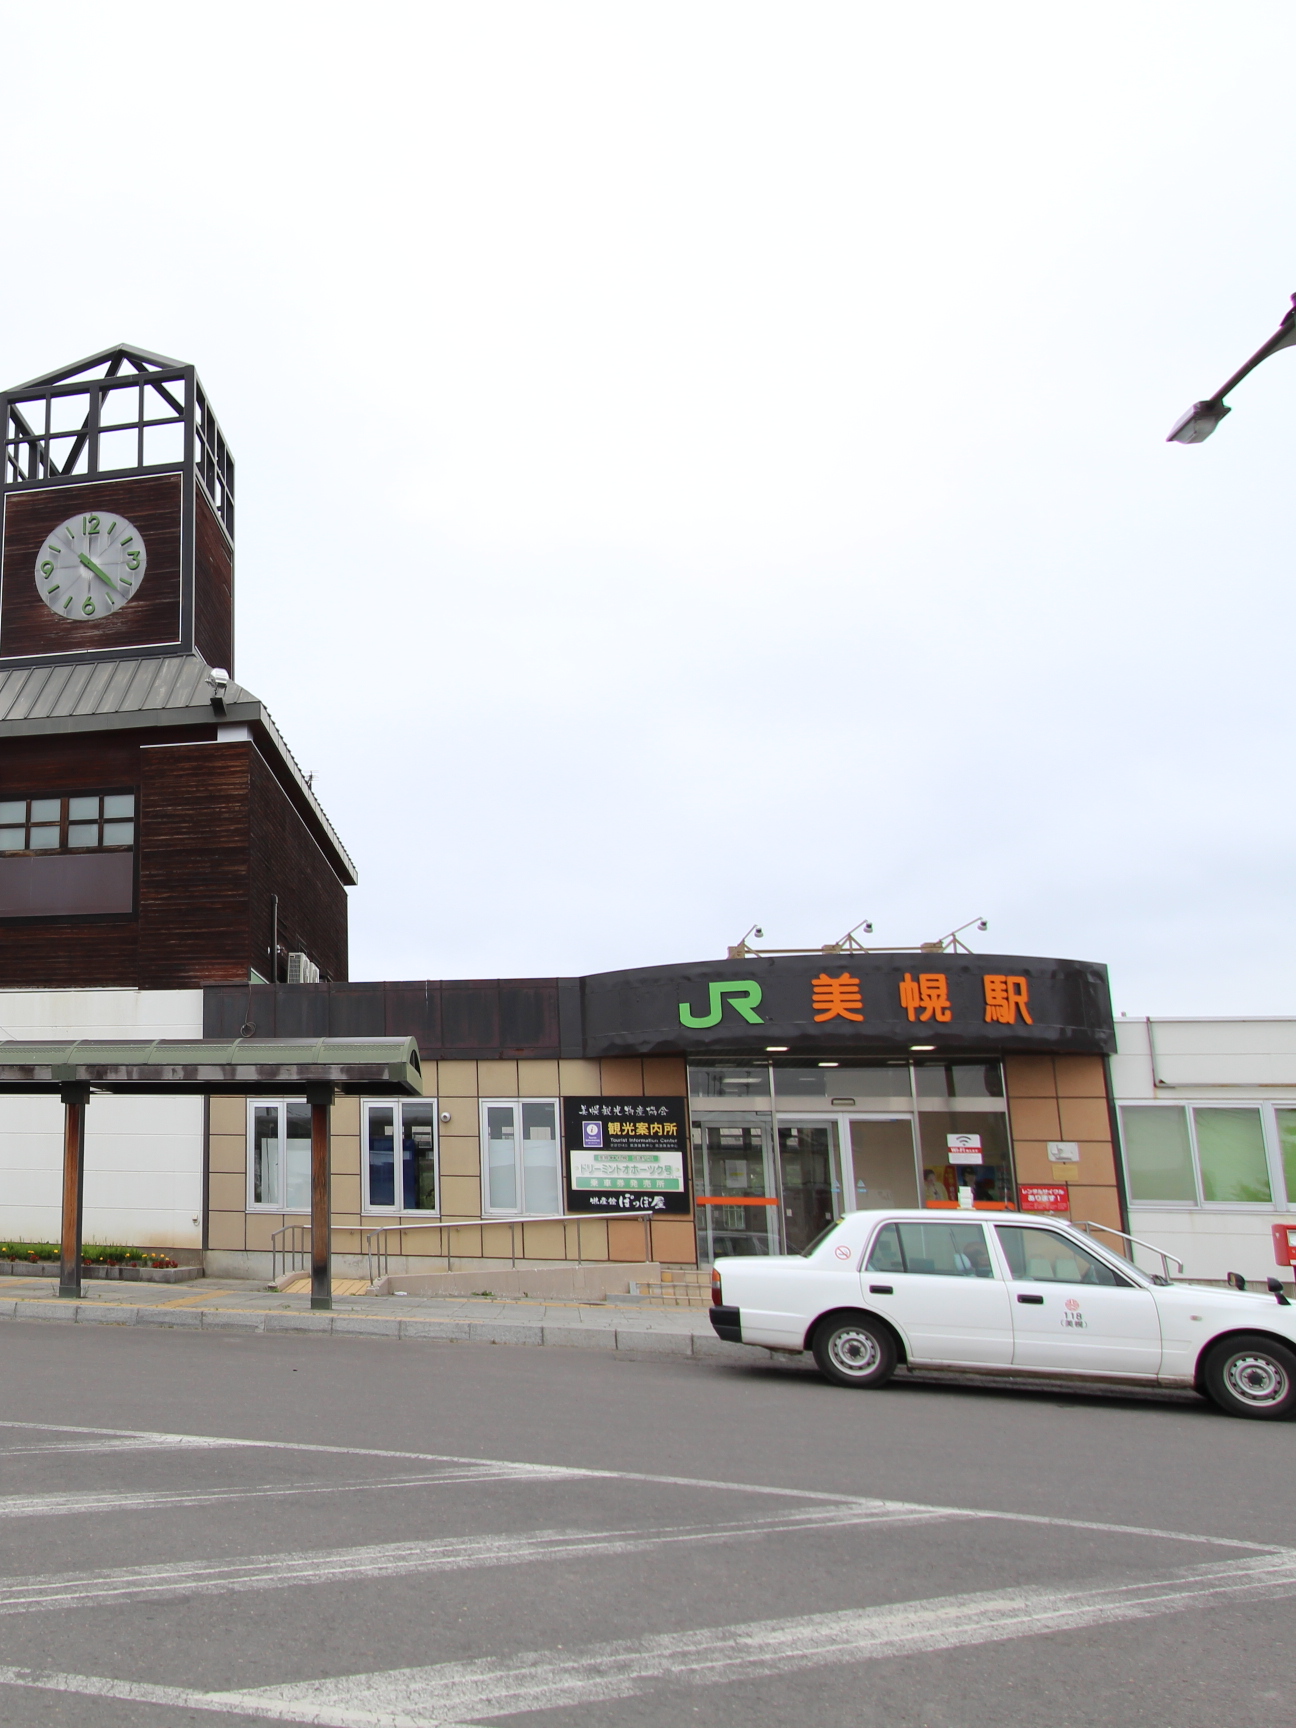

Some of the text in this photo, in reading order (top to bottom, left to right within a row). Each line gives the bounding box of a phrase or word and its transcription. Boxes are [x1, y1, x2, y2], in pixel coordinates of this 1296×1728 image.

[82, 515, 100, 536] 12
[40, 560, 55, 579] 9
[126, 550, 141, 571] 3
[81, 595, 96, 615] 6
[679, 980, 765, 1028] JR
[811, 972, 1034, 1025] 美幌駅
[607, 1122, 678, 1136] 観光案内所
[580, 1164, 674, 1176] ドリーミントオホーツク号
[590, 1179, 665, 1188] 乗車券発売所
[1021, 1187, 1065, 1195] レンタルサイクル
[1064, 1311, 1082, 1320] 118
